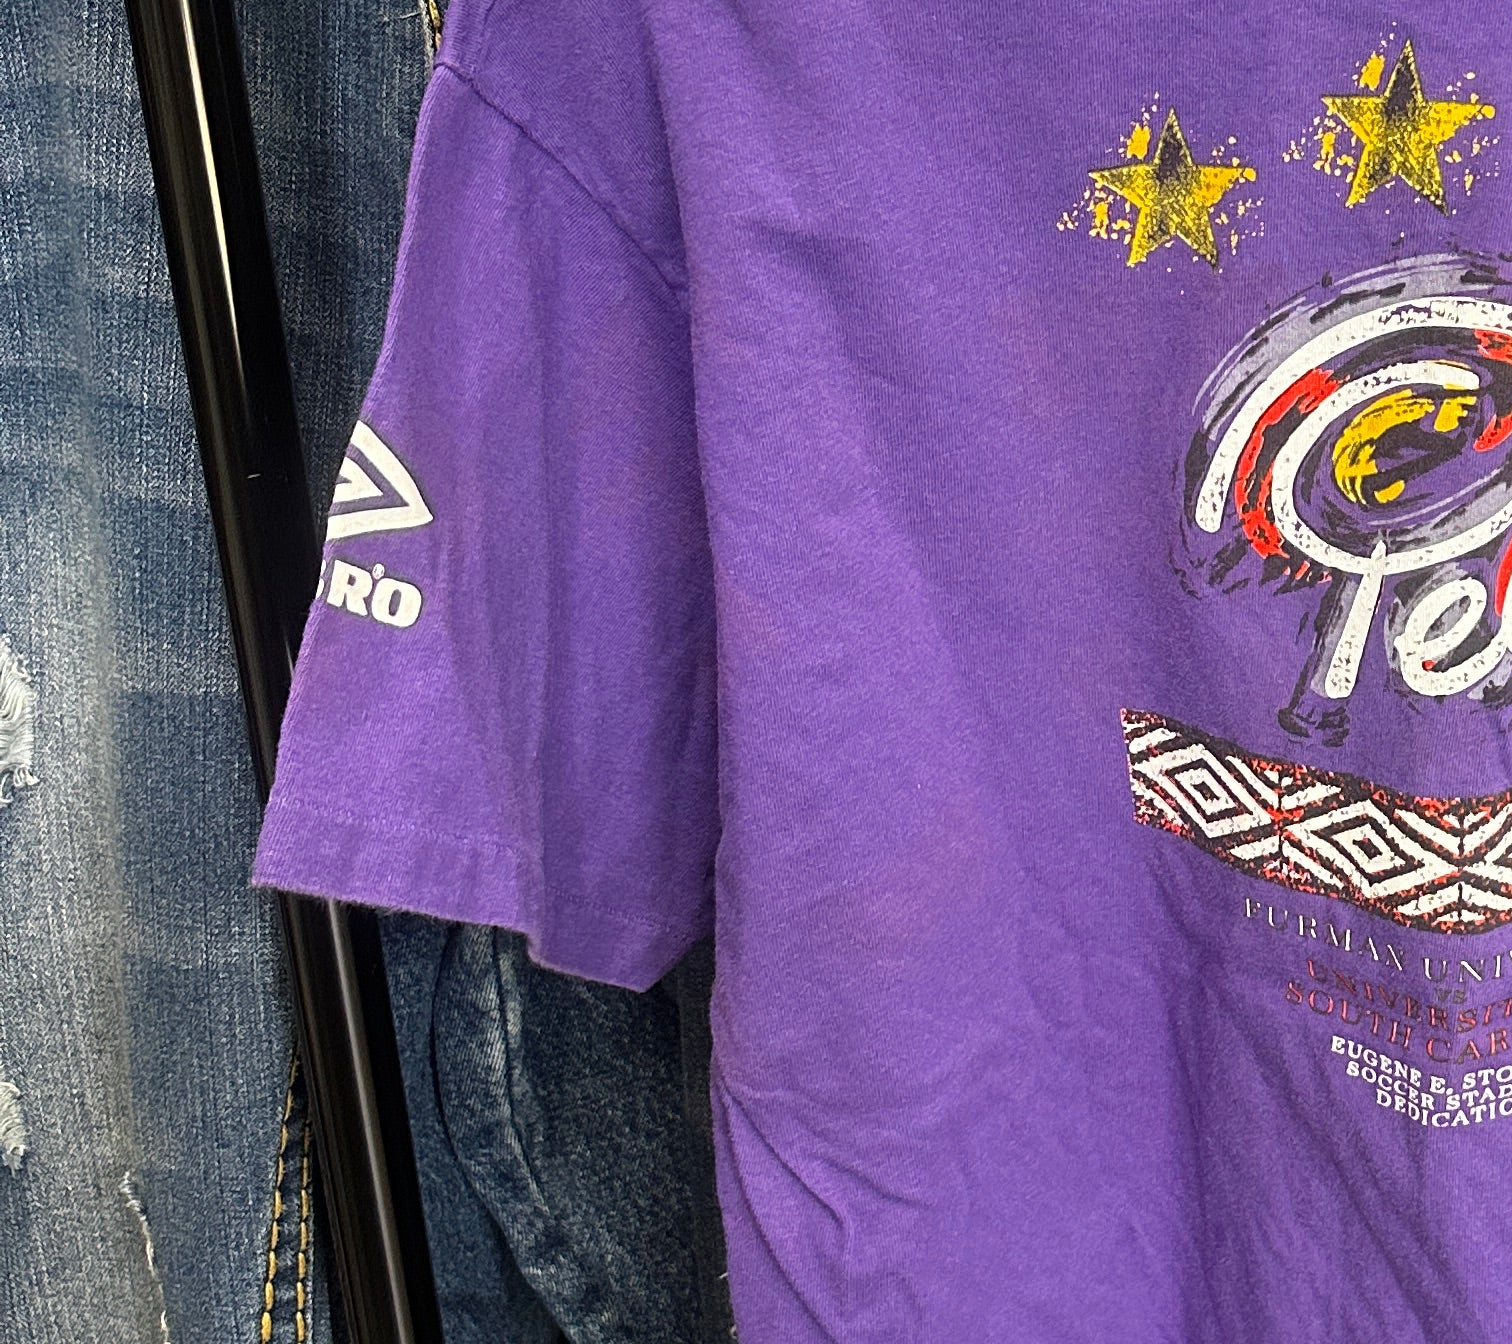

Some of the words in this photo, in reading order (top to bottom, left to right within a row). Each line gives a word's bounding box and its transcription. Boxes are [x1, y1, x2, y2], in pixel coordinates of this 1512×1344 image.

[316, 559, 423, 628] RO
[1244, 897, 1404, 971] FURMAN
[1285, 980, 1412, 1050] SOUTH
[1331, 1035, 1422, 1087] EUGENE
[1430, 1076, 1454, 1095] E.
[1346, 1061, 1435, 1111] SOCCER
